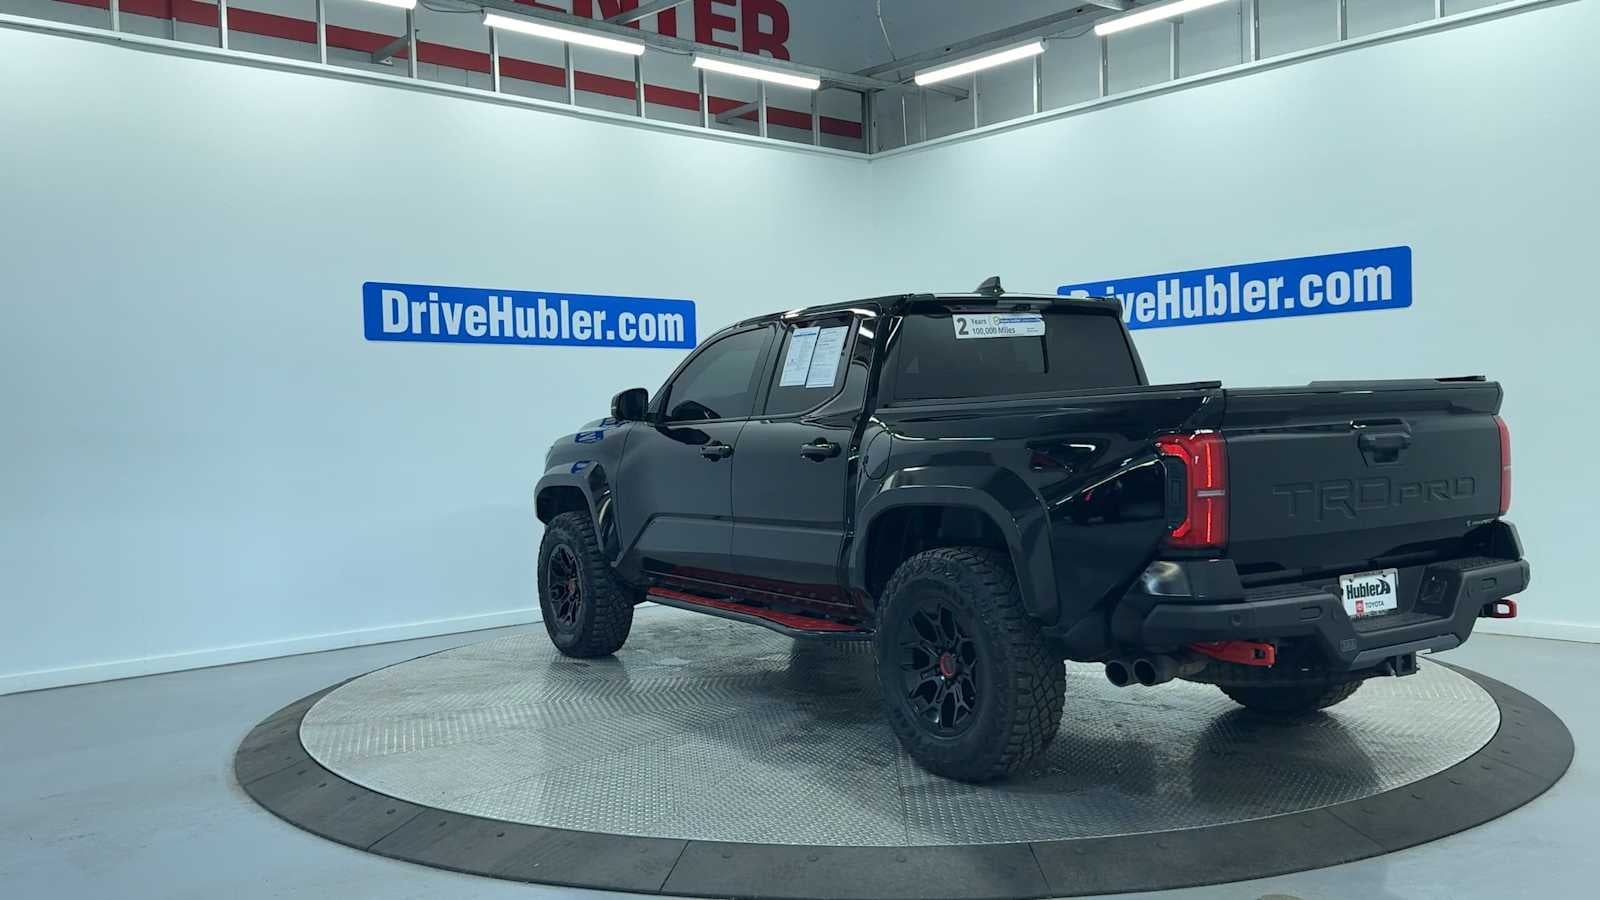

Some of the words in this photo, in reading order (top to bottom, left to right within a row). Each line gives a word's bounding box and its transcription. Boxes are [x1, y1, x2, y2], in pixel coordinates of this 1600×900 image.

[1070, 264, 1392, 324] veHubler.com
[381, 289, 685, 342] DriveHubler.com
[957, 318, 969, 335] 2
[1393, 476, 1476, 506] PRO
[1346, 582, 1382, 599] Hubler
[1365, 601, 1385, 609] TOYOTA
